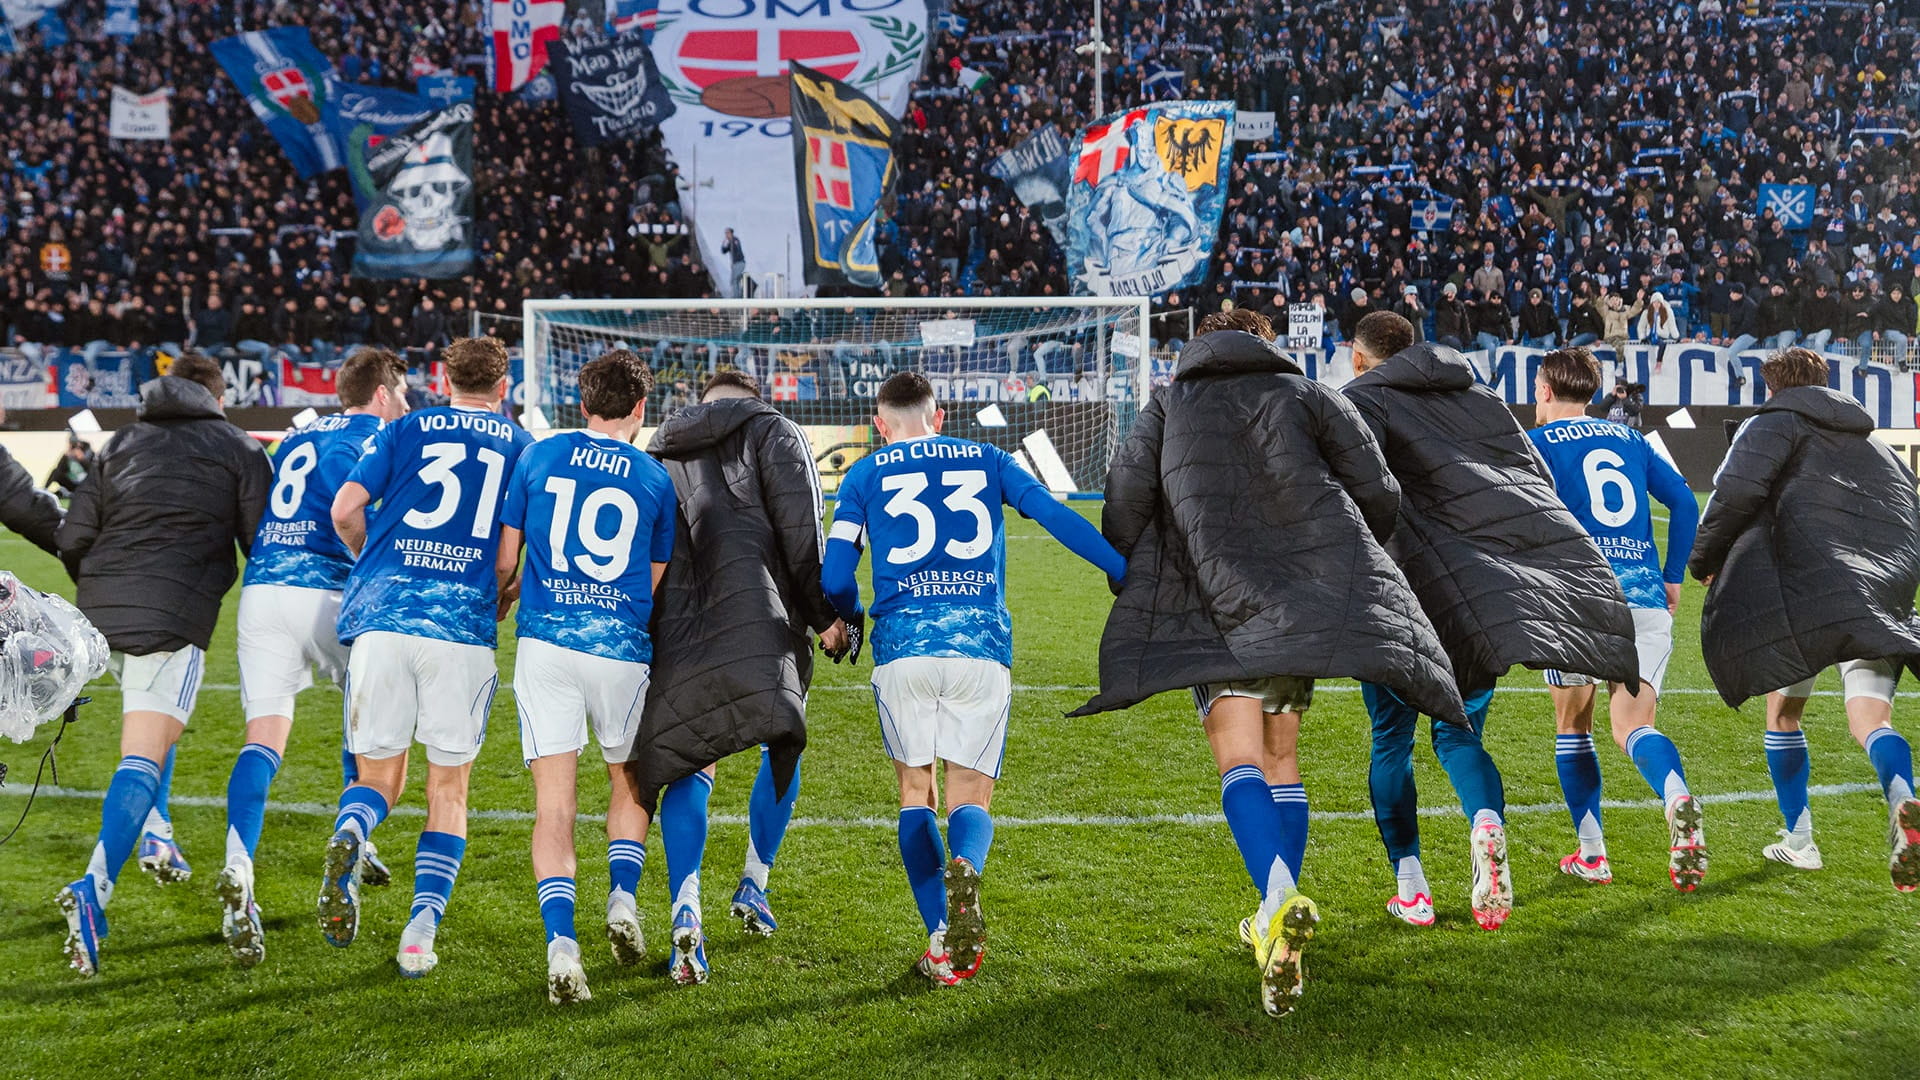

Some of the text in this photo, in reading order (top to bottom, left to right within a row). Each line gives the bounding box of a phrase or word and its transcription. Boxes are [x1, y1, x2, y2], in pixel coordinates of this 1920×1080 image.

[1296, 326, 1308, 336] LA
[419, 415, 513, 443] VOJVODA
[569, 447, 632, 478] KÜHN
[875, 443, 983, 466] DA CUNHA
[271, 441, 317, 519] 8
[402, 442, 505, 539] 31
[1582, 448, 1637, 528] 6
[882, 470, 993, 565] 33
[544, 476, 639, 583] 19
[394, 538, 482, 561] NEUBERGER
[1592, 536, 1652, 549] UBERGER
[403, 554, 466, 573] BERMAN
[542, 578, 631, 602] NEUBERGER
[897, 570, 995, 592] NEUBERGER
[913, 585, 981, 598] BERMAN
[555, 592, 617, 611] BERMAN
